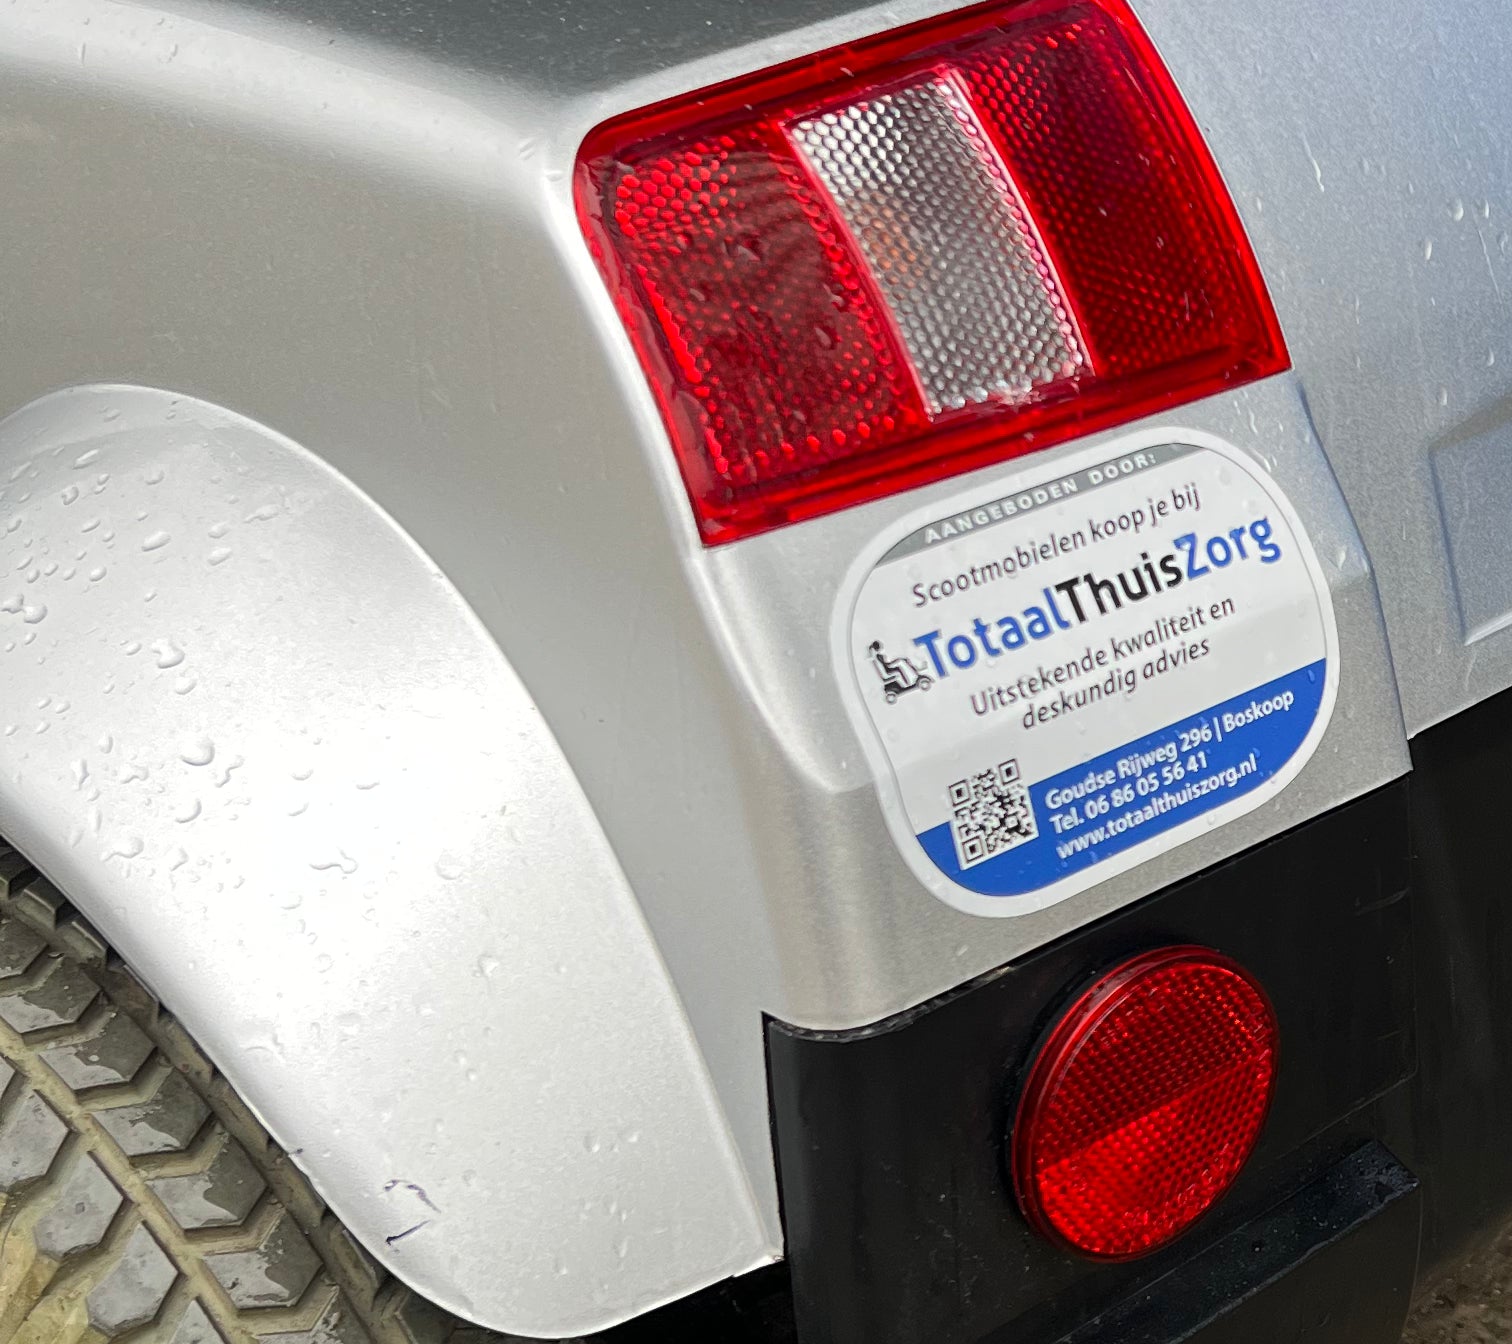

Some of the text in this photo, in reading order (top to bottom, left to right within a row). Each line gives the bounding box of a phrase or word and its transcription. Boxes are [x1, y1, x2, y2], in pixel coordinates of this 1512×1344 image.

[912, 481, 1201, 609] Scootmobielen koop je bij
[924, 453, 1157, 544] AANGEBODEN DOOR:
[912, 517, 1283, 679] TotaalThuisZorg
[970, 597, 1236, 717] Uitstekende kwaliteit en
[1022, 637, 1211, 731] deskundig advies
[1045, 767, 1116, 810] Goudse
[1115, 740, 1178, 780] Rijweg
[1179, 723, 1212, 753] 296
[1222, 690, 1295, 733] Boskoop
[1049, 750, 1208, 834] Tel. 06 86 05 56 41
[1056, 752, 1258, 860] www.totaalthuiszorg.nl
